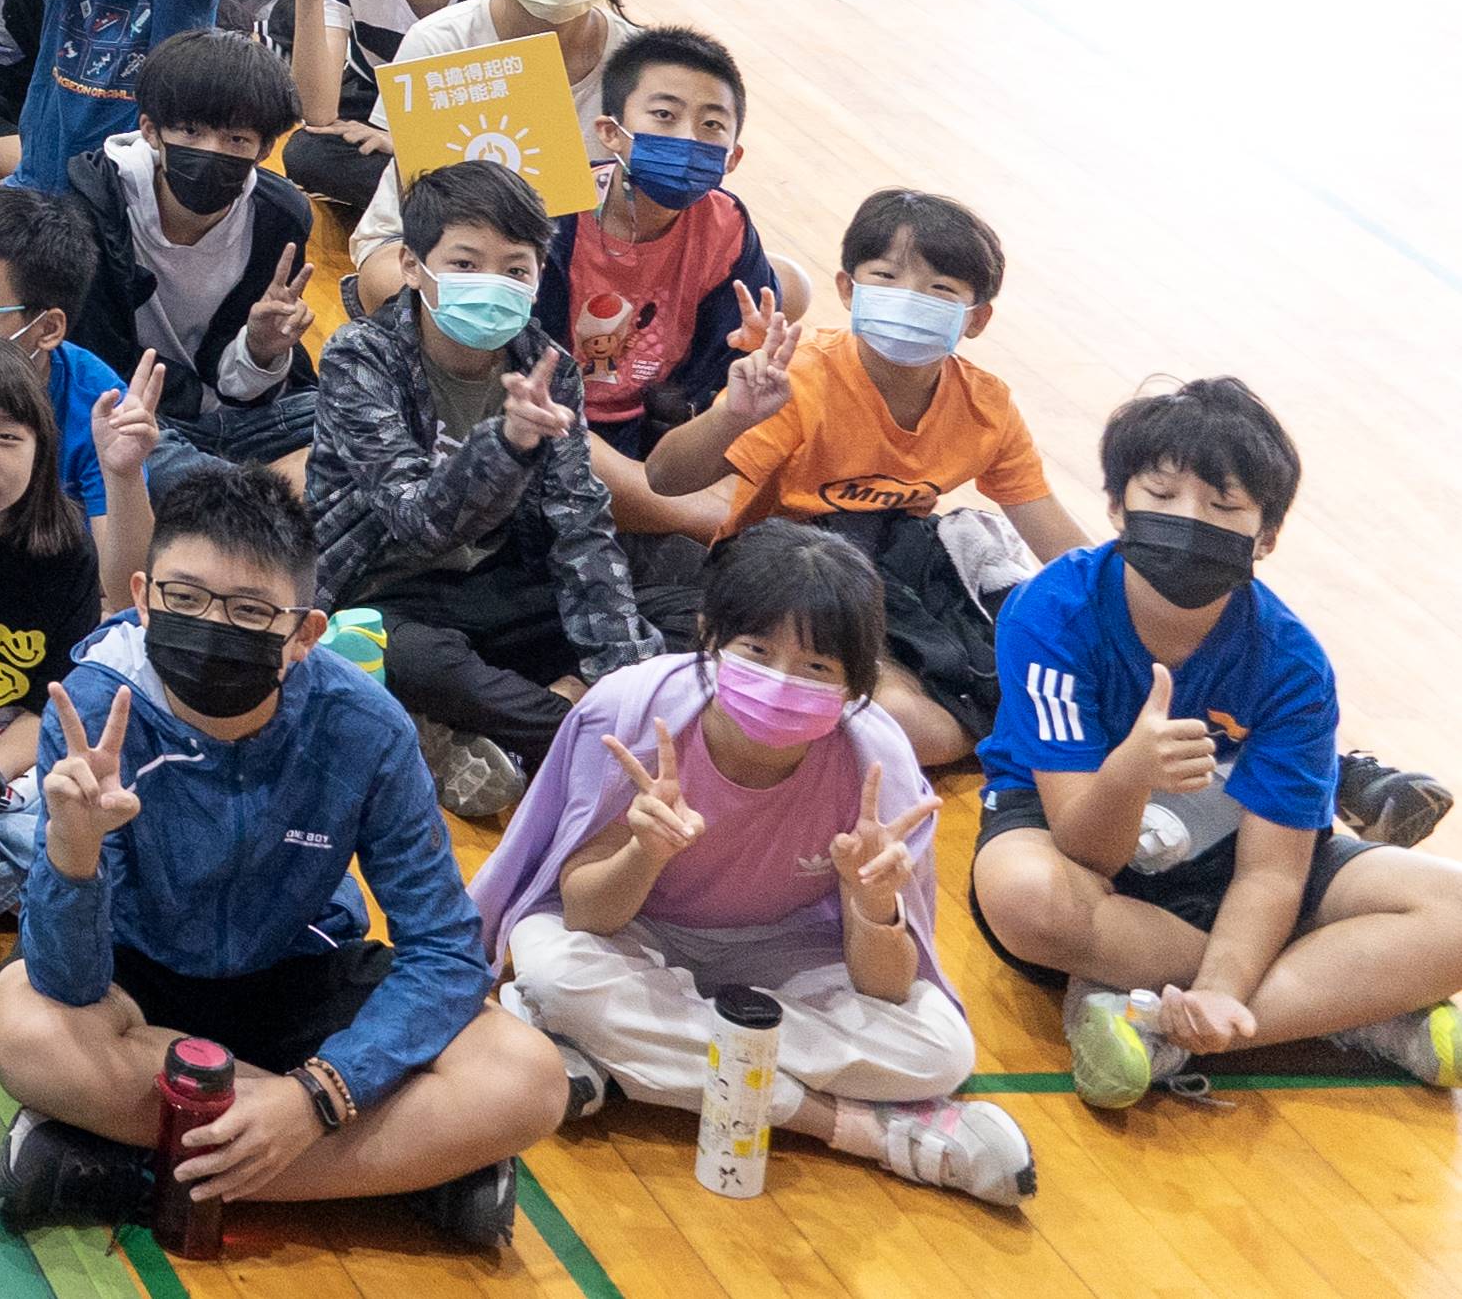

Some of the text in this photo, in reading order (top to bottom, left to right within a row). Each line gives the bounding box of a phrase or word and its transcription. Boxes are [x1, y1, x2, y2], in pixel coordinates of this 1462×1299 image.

[423, 55, 524, 90] 負擔得起的
[394, 73, 414, 114] 7
[427, 78, 510, 111] 清淨能源
[306, 832, 330, 843] BOY
